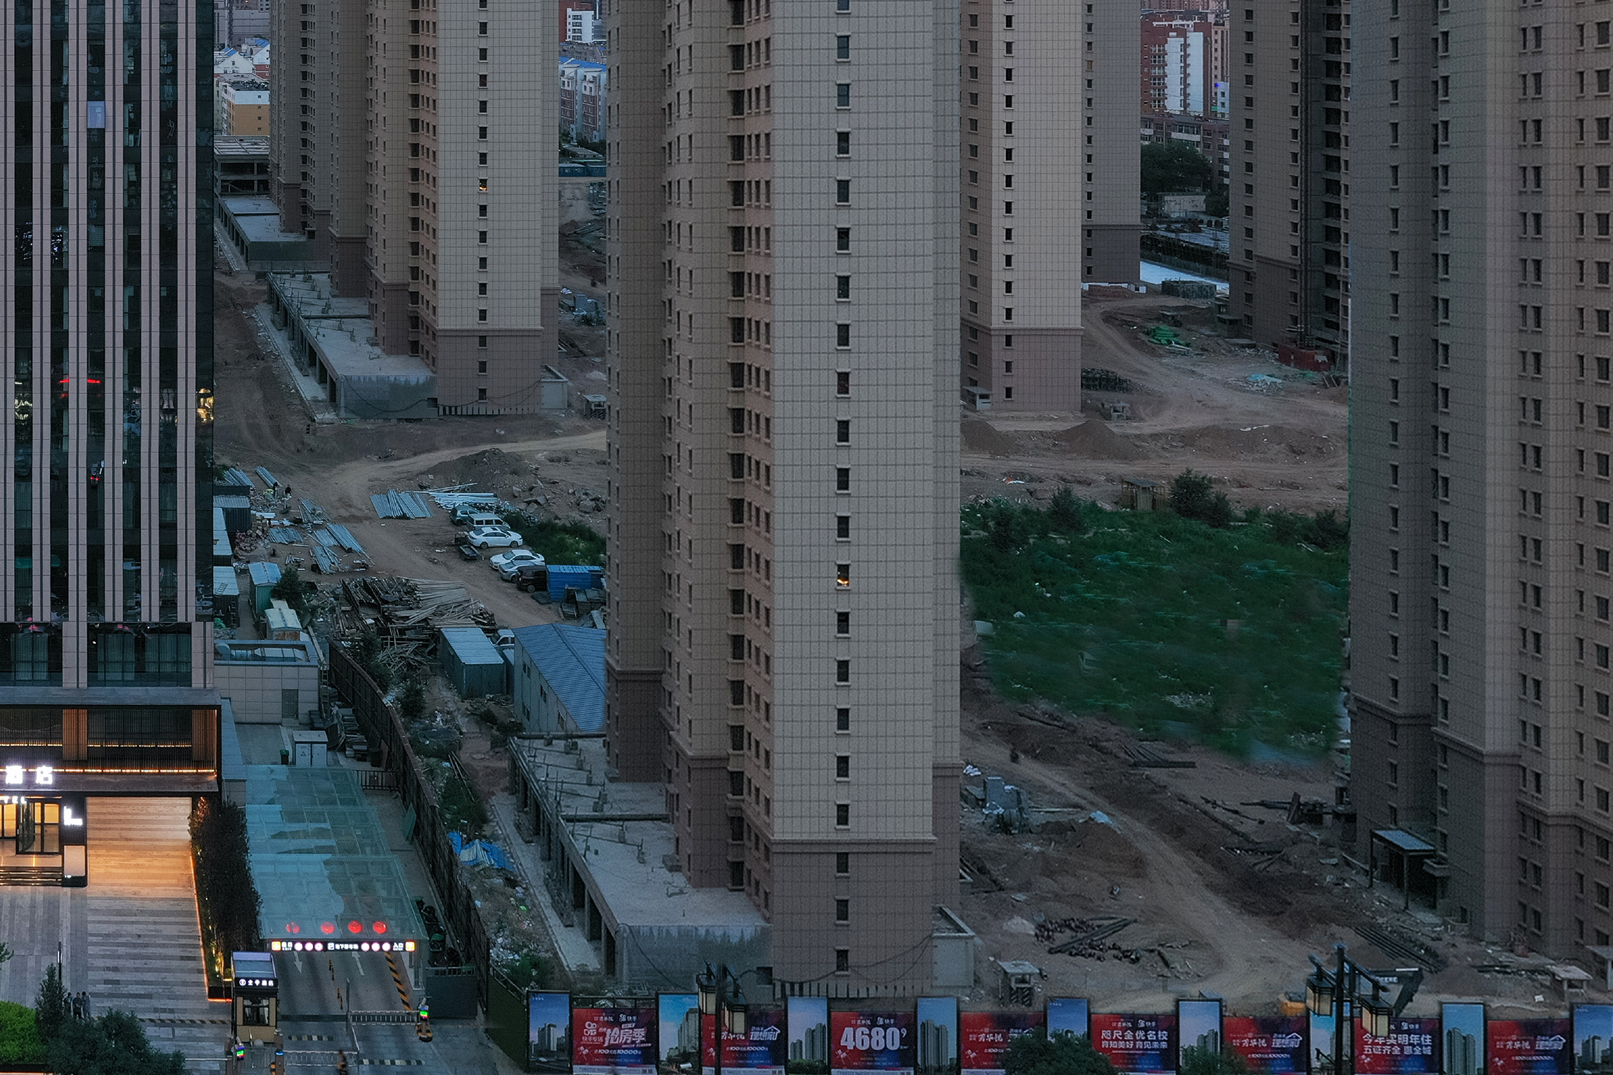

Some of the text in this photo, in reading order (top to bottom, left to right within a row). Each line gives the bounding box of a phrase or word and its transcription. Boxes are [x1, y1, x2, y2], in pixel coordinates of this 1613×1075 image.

[840, 1026, 900, 1051] 4680
[1101, 1029, 1168, 1041] 咫尺全优名校
